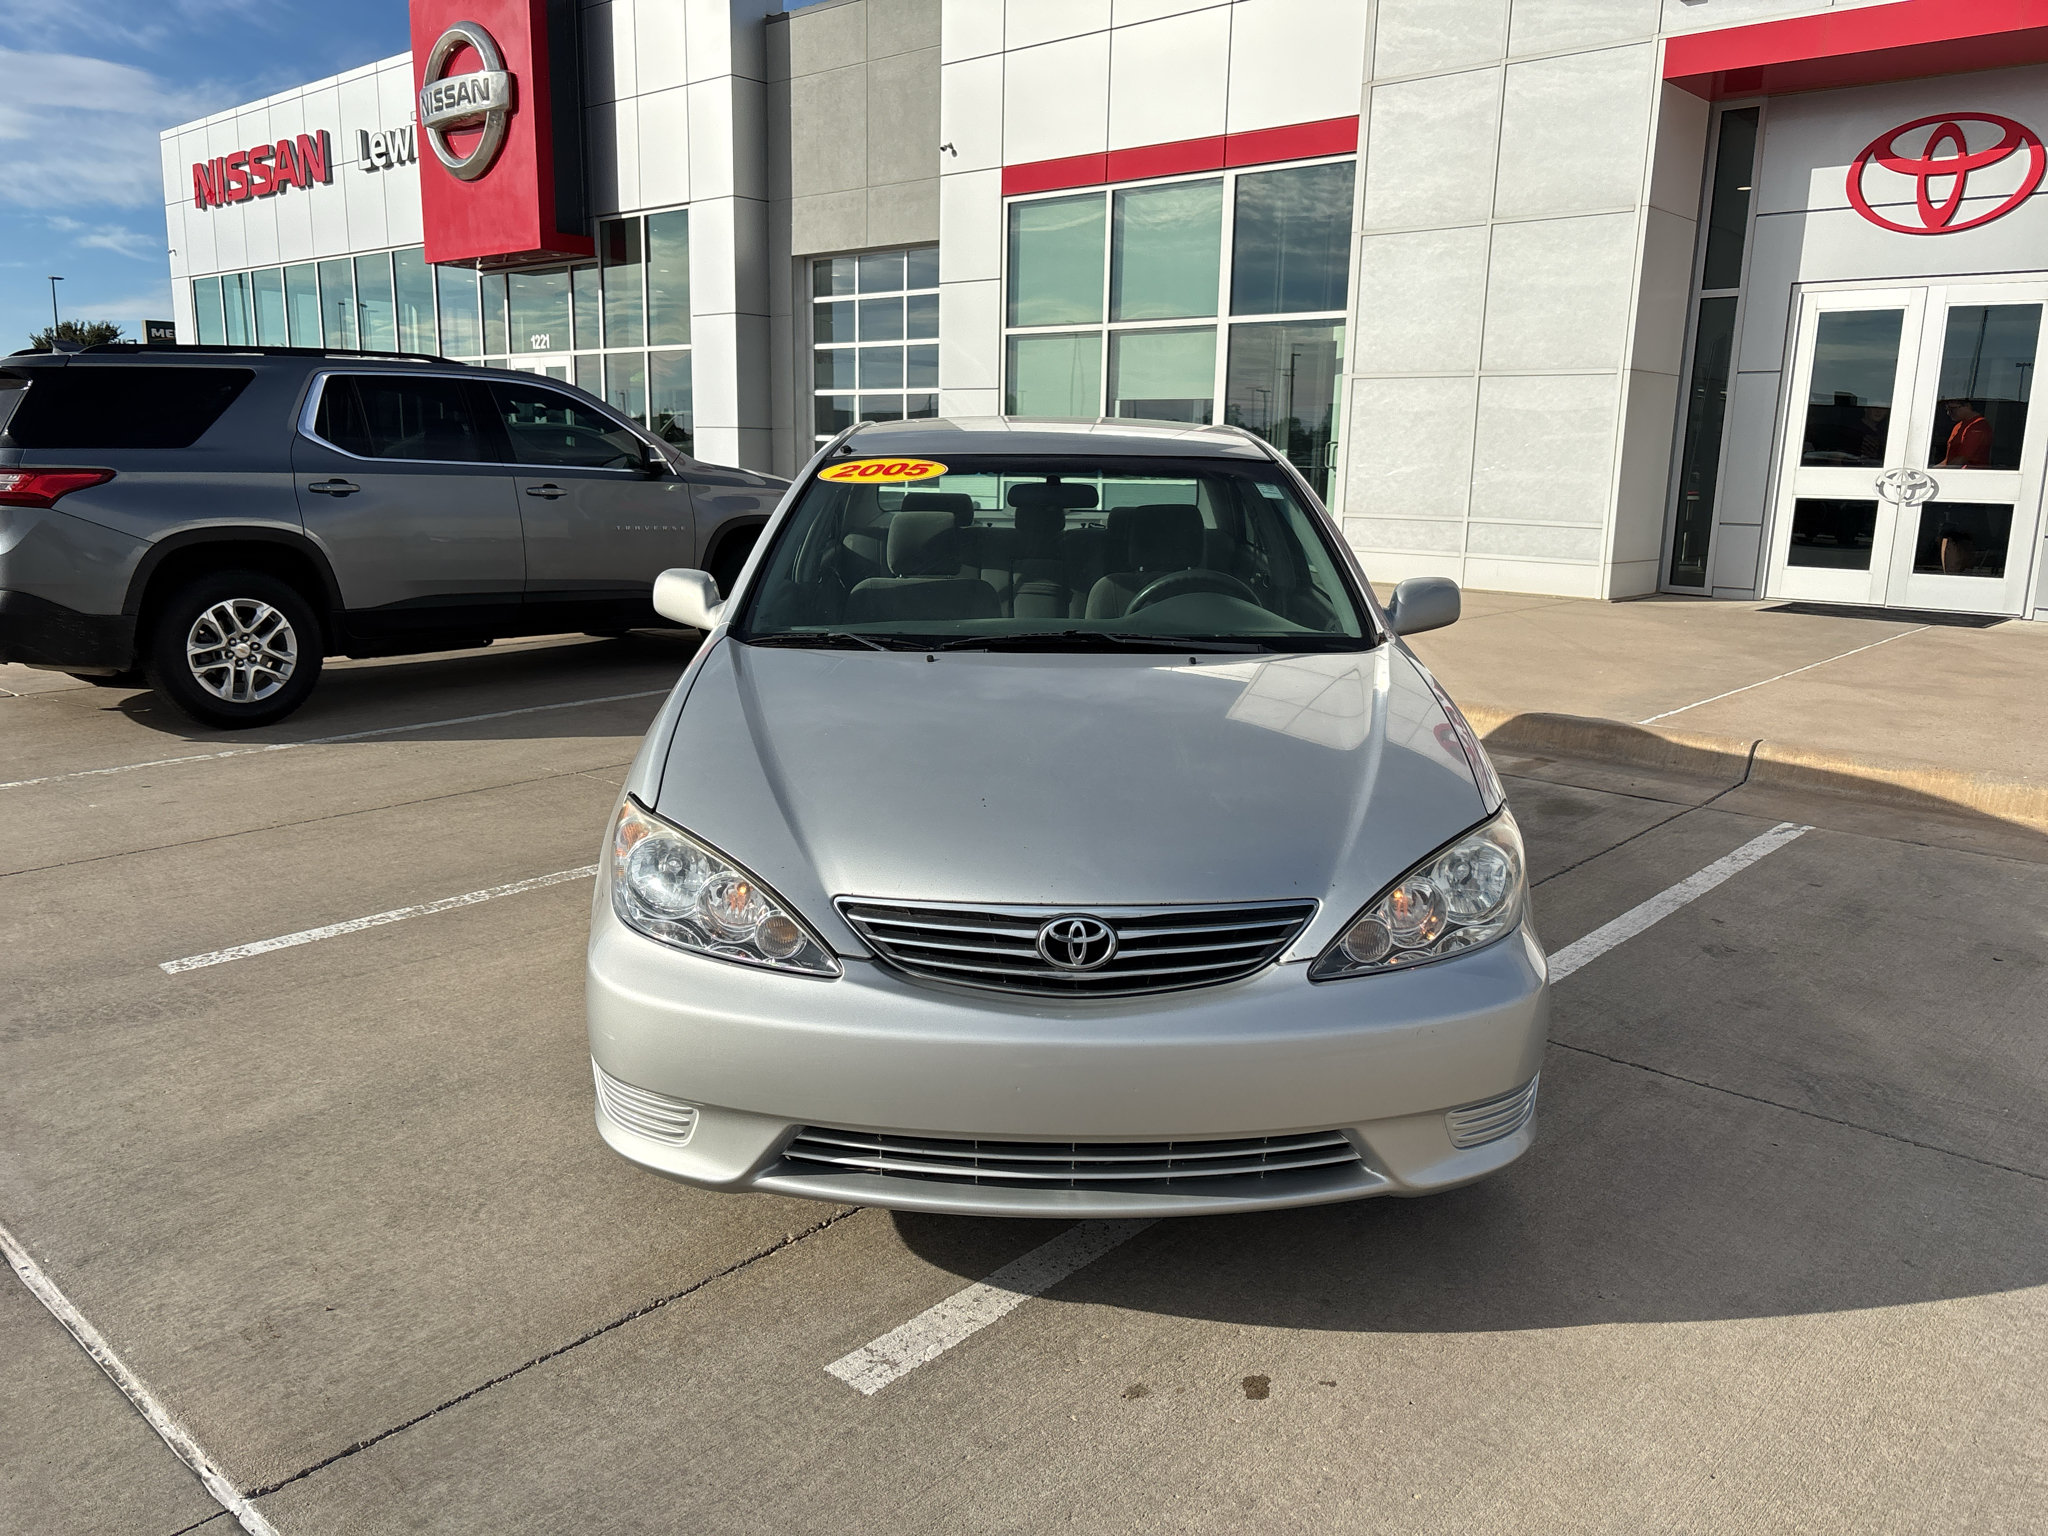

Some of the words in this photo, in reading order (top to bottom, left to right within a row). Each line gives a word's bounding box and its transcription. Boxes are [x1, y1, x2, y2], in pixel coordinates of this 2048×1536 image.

[421, 77, 490, 117] NISSAN
[193, 129, 330, 210] NISSAN
[530, 333, 550, 350] 1221
[830, 463, 934, 478] 2005
